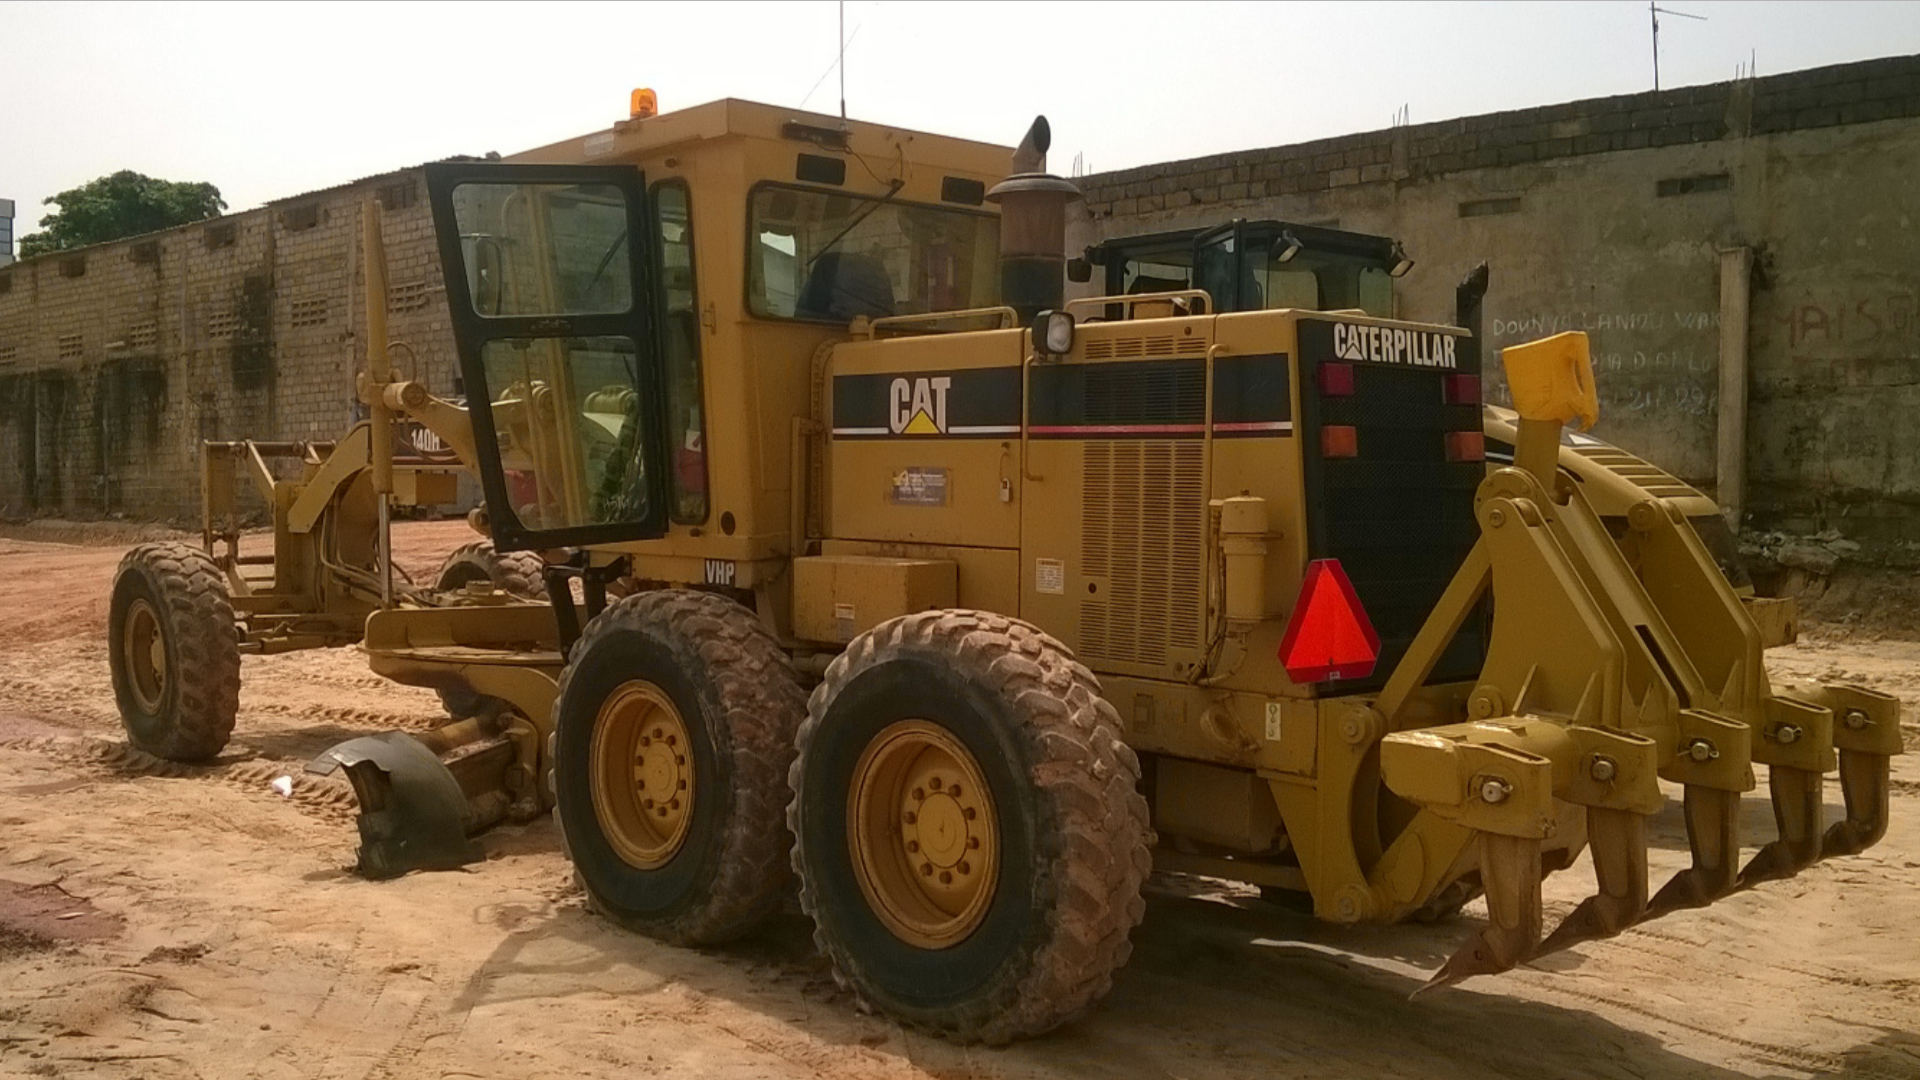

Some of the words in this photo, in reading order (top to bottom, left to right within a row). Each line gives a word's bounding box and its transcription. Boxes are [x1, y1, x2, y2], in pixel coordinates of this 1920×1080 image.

[1334, 322, 1456, 369] CATERPILLAR
[890, 376, 951, 434] CAT
[411, 428, 440, 451] 140H
[705, 560, 735, 585] VHP
